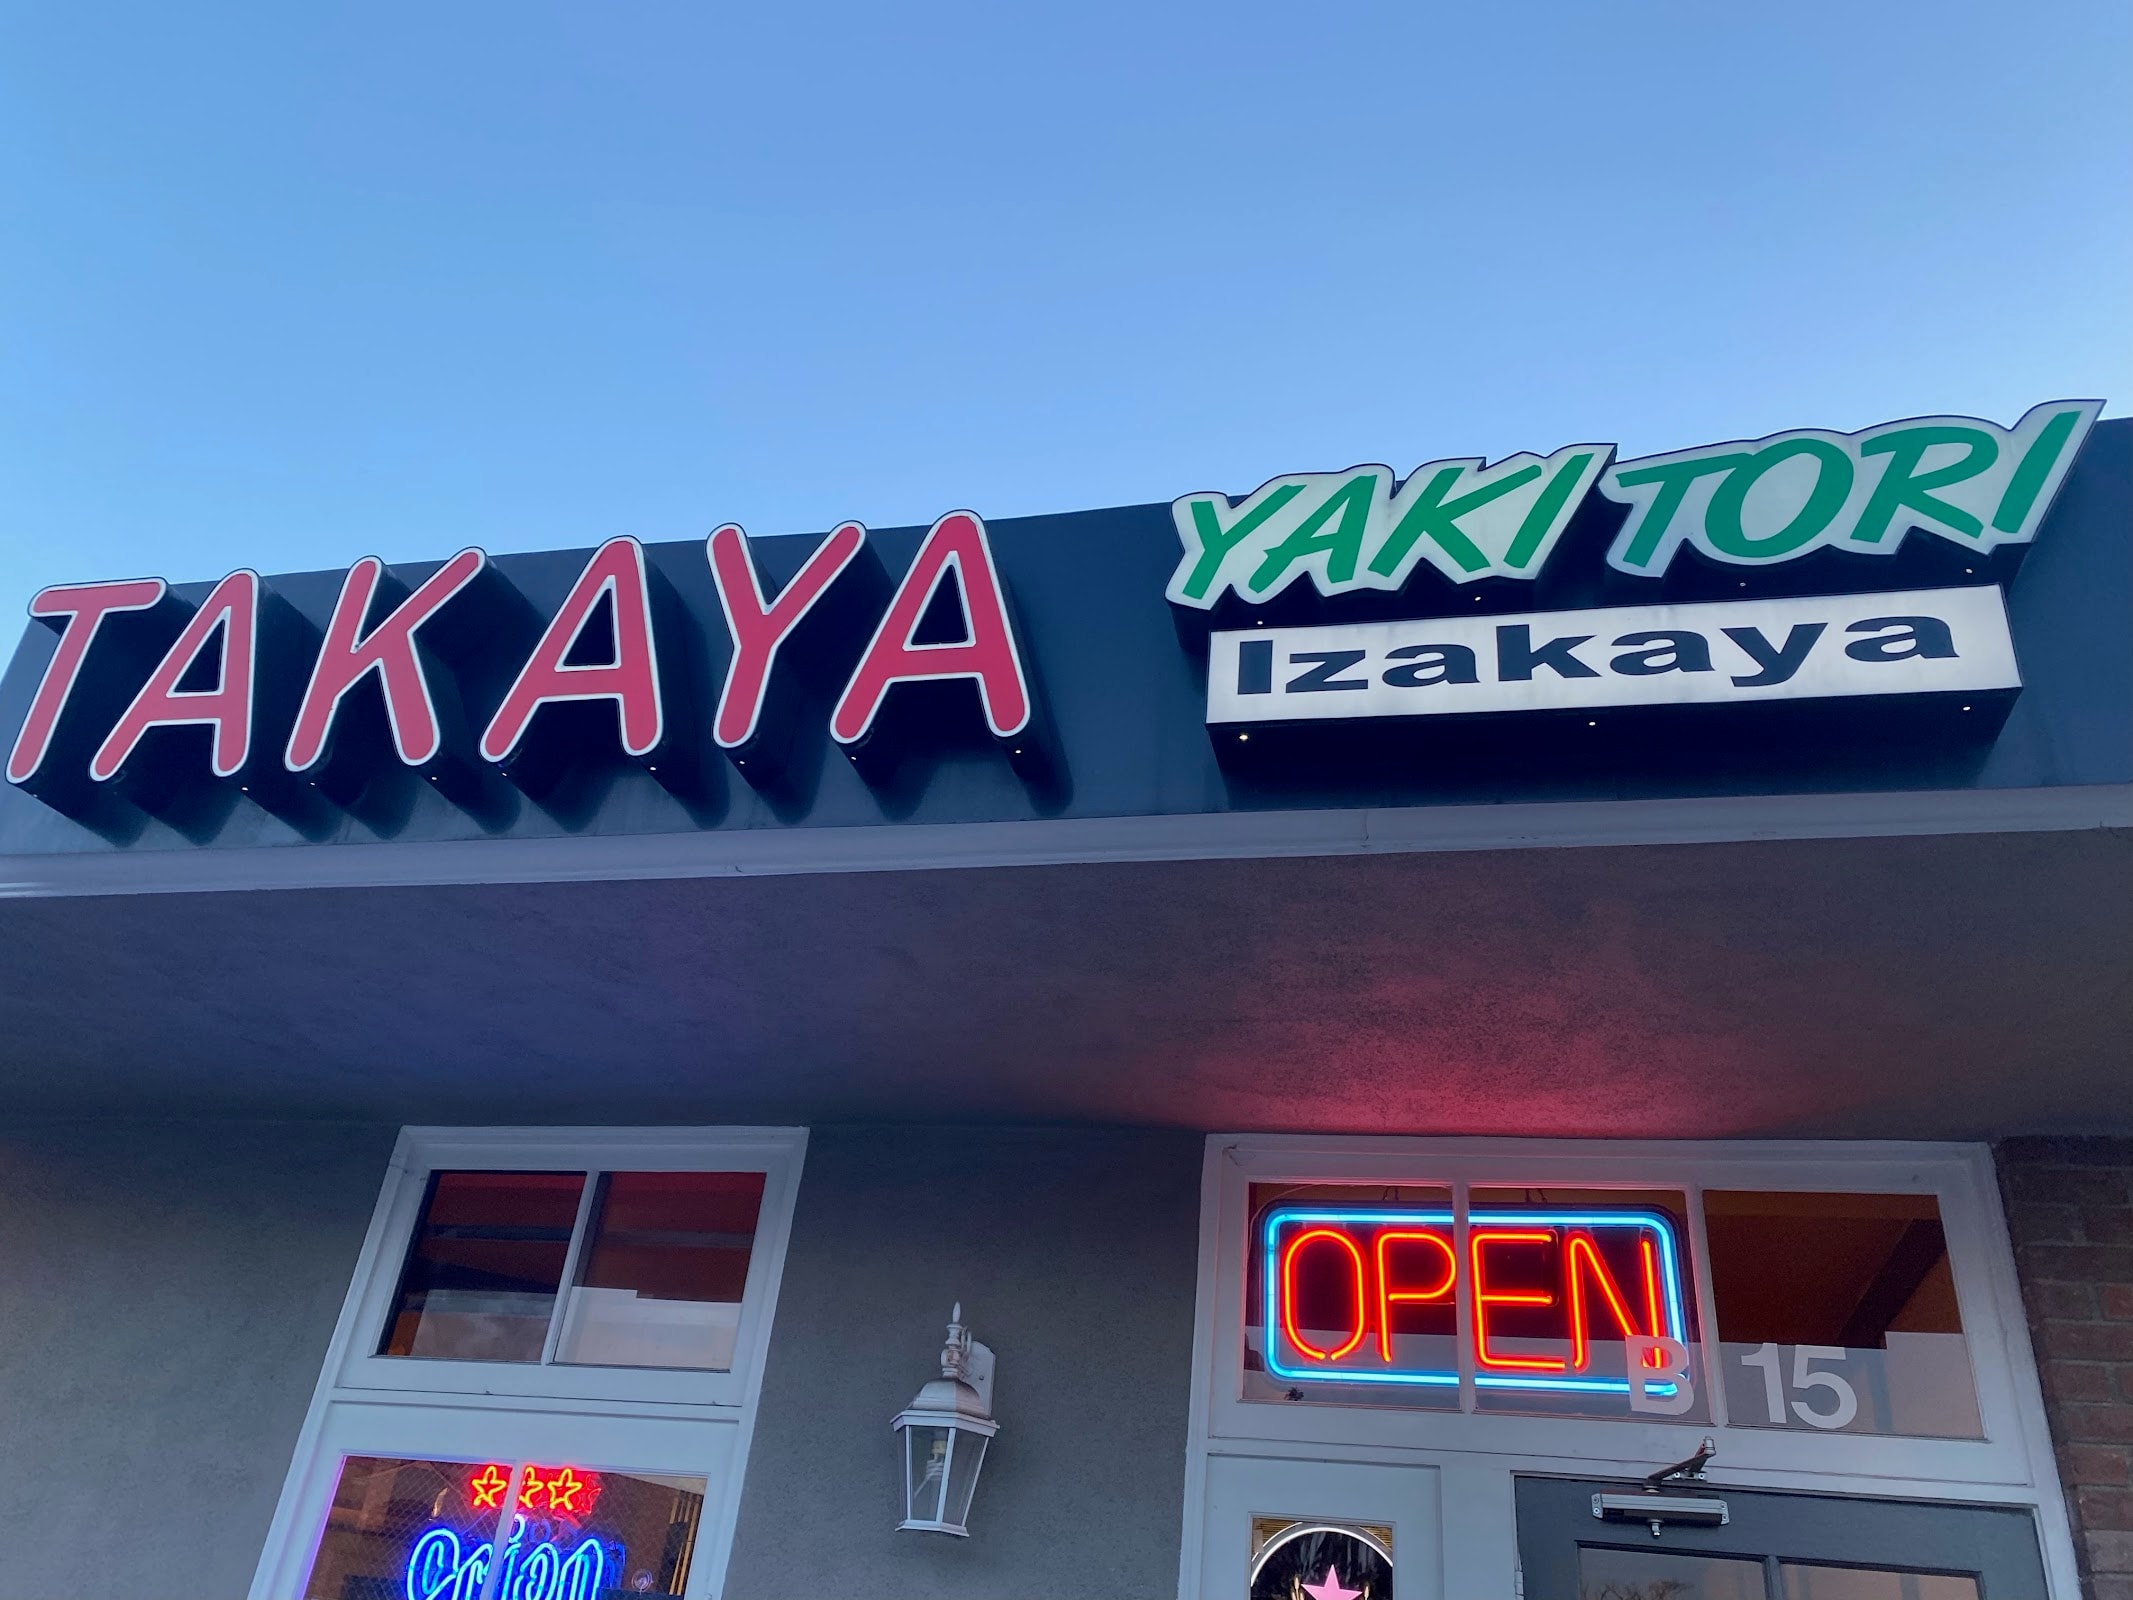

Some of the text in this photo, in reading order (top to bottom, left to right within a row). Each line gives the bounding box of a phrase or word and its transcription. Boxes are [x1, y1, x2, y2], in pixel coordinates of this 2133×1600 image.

[5, 509, 1031, 784] TAKAYA
[1236, 615, 1961, 696] Izakaya
[1282, 1228, 1665, 1371] OPEN
[1625, 1334, 1858, 1429] B 15
